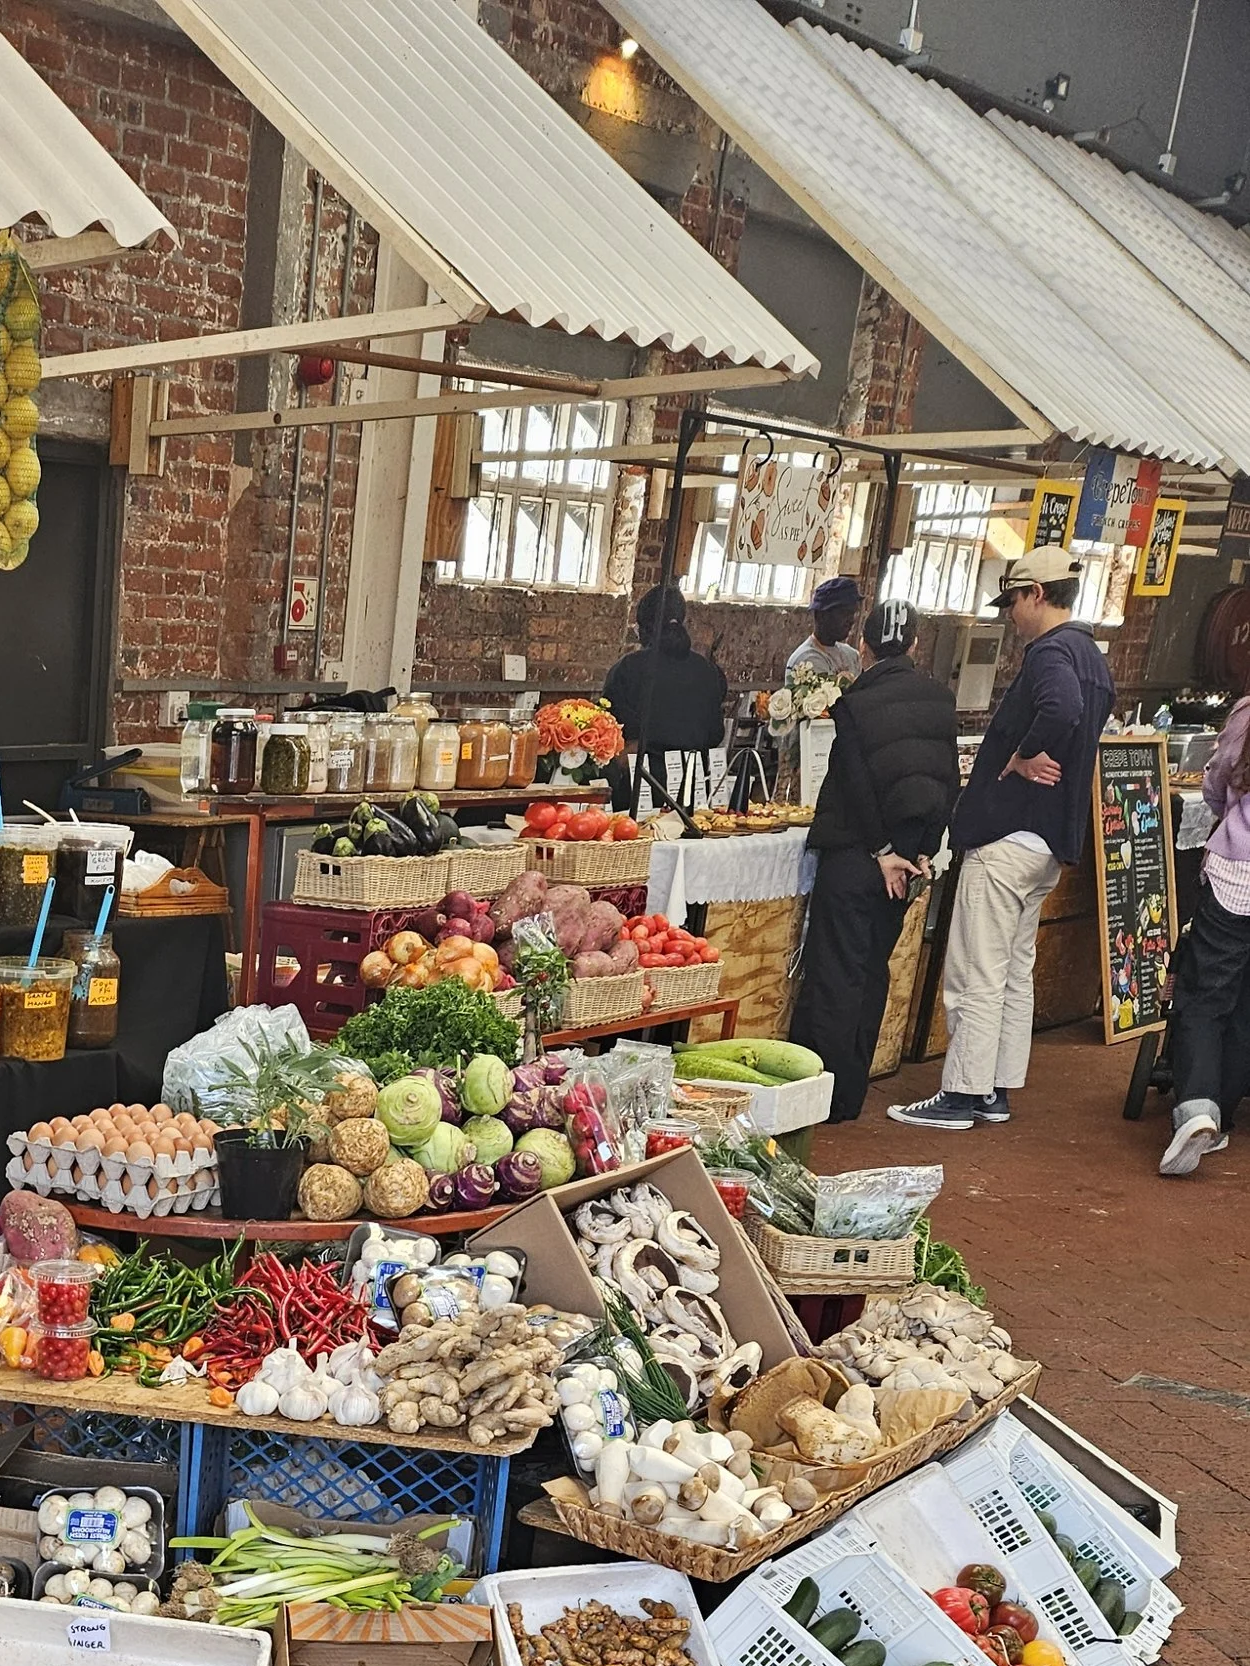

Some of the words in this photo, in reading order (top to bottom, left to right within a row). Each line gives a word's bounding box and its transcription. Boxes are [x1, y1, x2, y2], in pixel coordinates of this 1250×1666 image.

[771, 467, 818, 537] Sweet
[1091, 514, 1116, 528] FRENCH
[780, 527, 788, 540] AS
[790, 527, 801, 542] PIE
[1102, 749, 1128, 768] CREPE
[1129, 748, 1154, 767] TOWN
[71, 1526, 111, 1534] MUSHROOMS
[70, 1623, 107, 1632] STRONG
[68, 1637, 106, 1649] INGER
